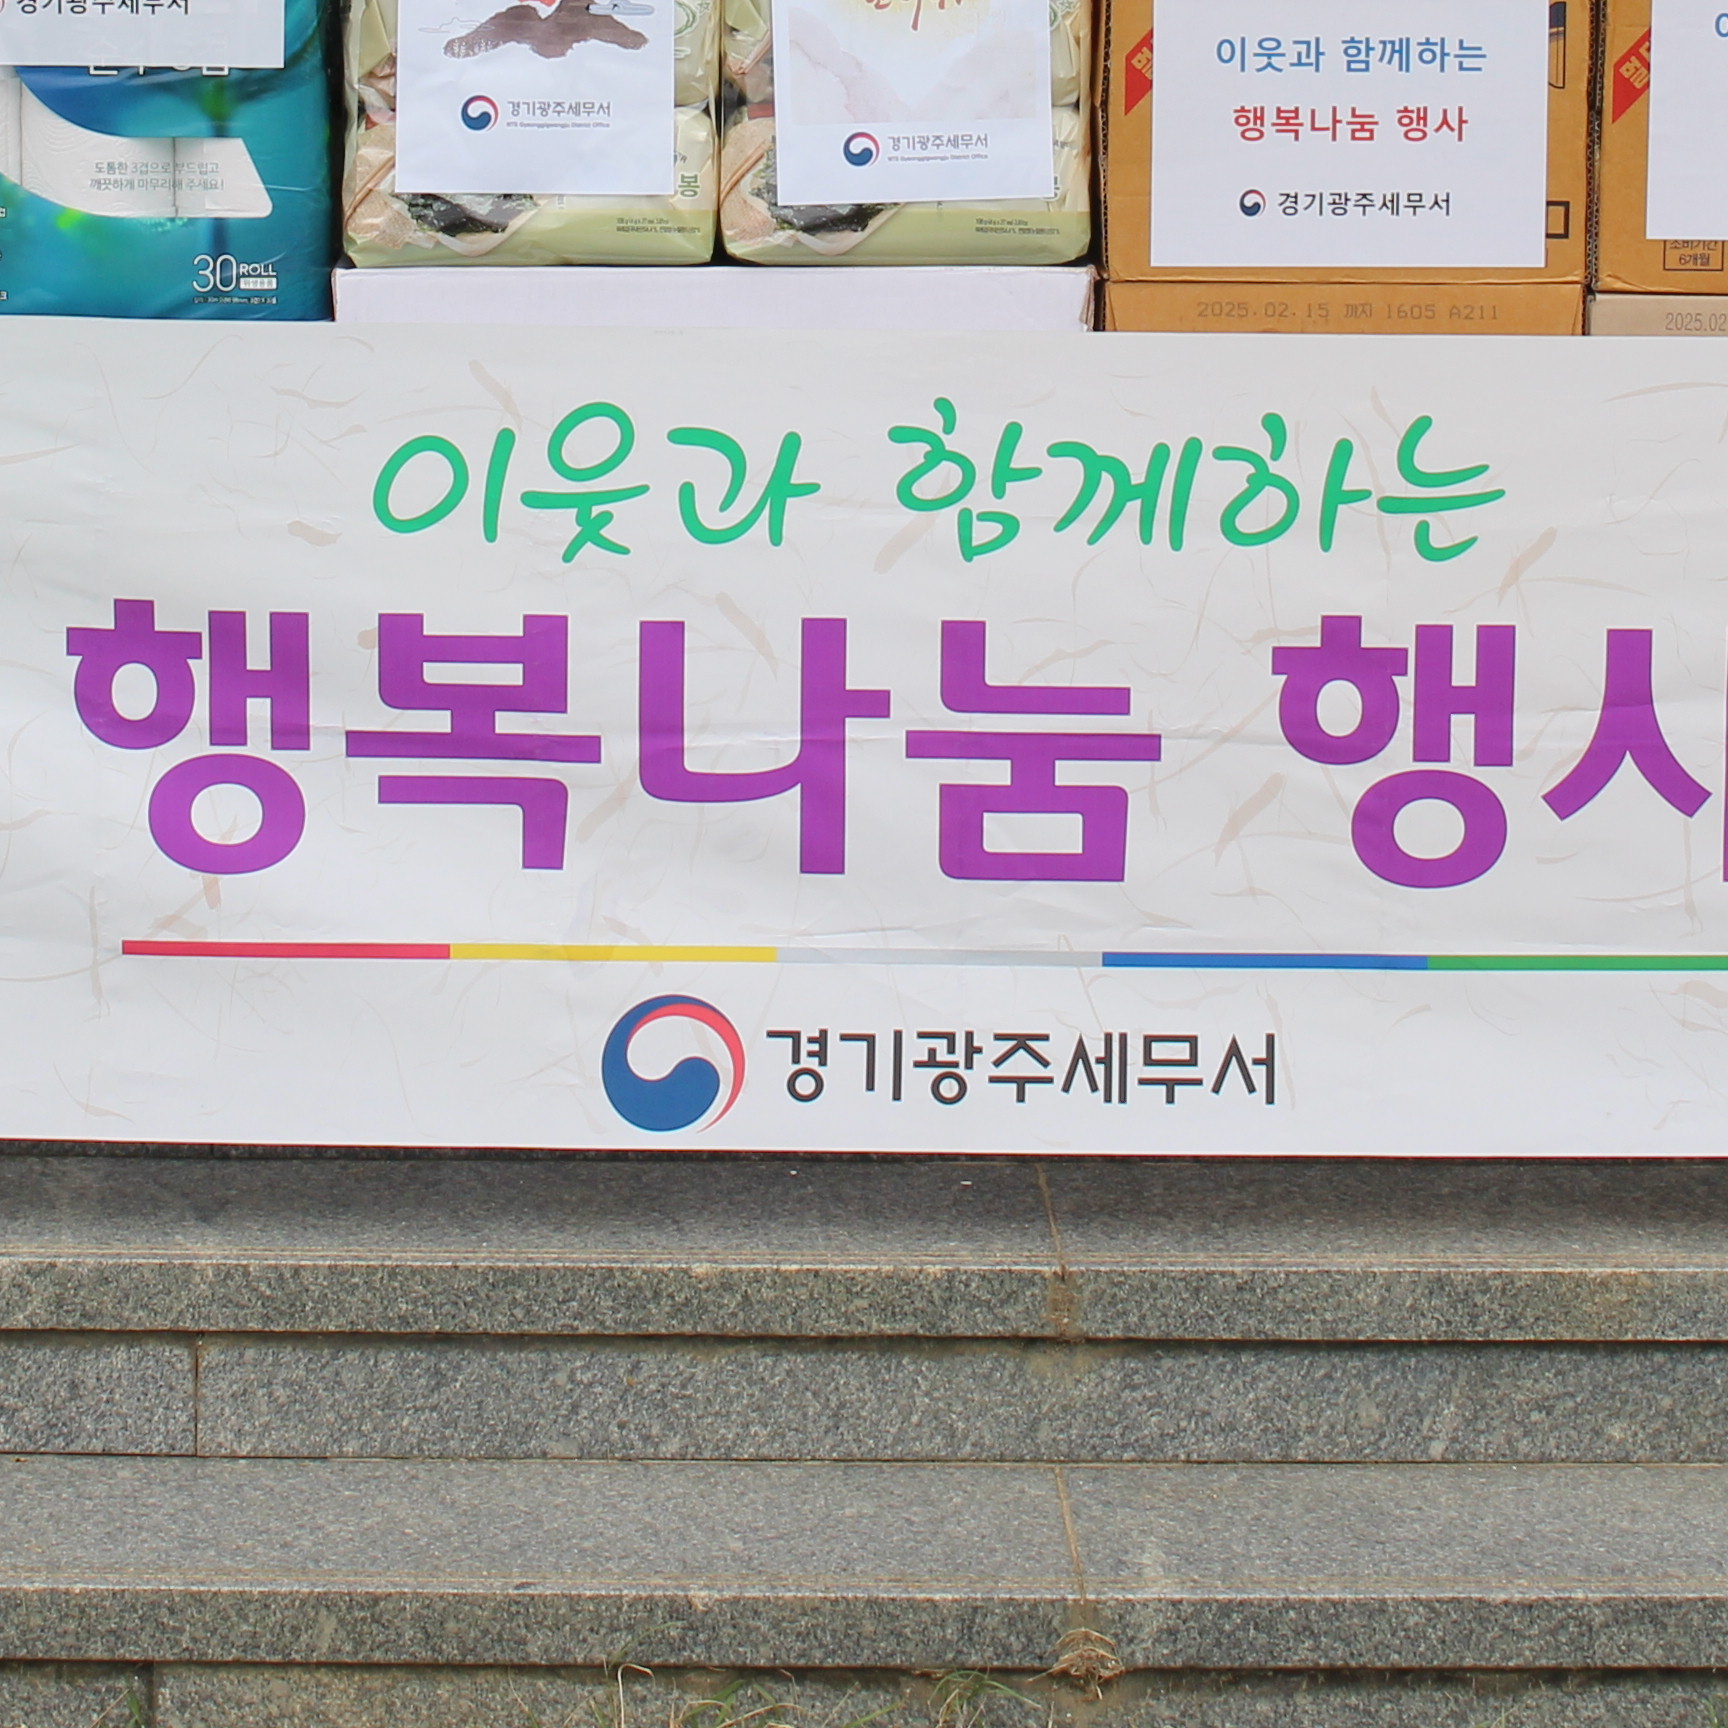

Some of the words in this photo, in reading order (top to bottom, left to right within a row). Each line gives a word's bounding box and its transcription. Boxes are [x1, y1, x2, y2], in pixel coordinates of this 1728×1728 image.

[1214, 35, 1327, 74] 이웃과
[1340, 35, 1488, 75] 함께하는
[506, 99, 612, 119] 경기광주세무서
[1232, 104, 1381, 144] 행복나눔
[1395, 105, 1470, 143] 행사
[886, 133, 989, 151] 경기광주세무서
[95, 161, 129, 176] 도톰한
[131, 161, 172, 175] 3겹으로
[173, 161, 220, 176] 부드럽고
[90, 177, 136, 192] 깨끗하게
[137, 177, 184, 192] 마무리해
[185, 177, 225, 192] 주세요!
[677, 172, 701, 199] 봉
[1276, 190, 1453, 218] 경기광주세무서
[192, 253, 238, 293] 30
[239, 262, 278, 276] ROLL
[373, 400, 821, 564] 이웃과
[887, 394, 1510, 563] 함께하는
[65, 598, 1162, 888] 행복나눔
[766, 1027, 1276, 1106] 경기광주세무서
